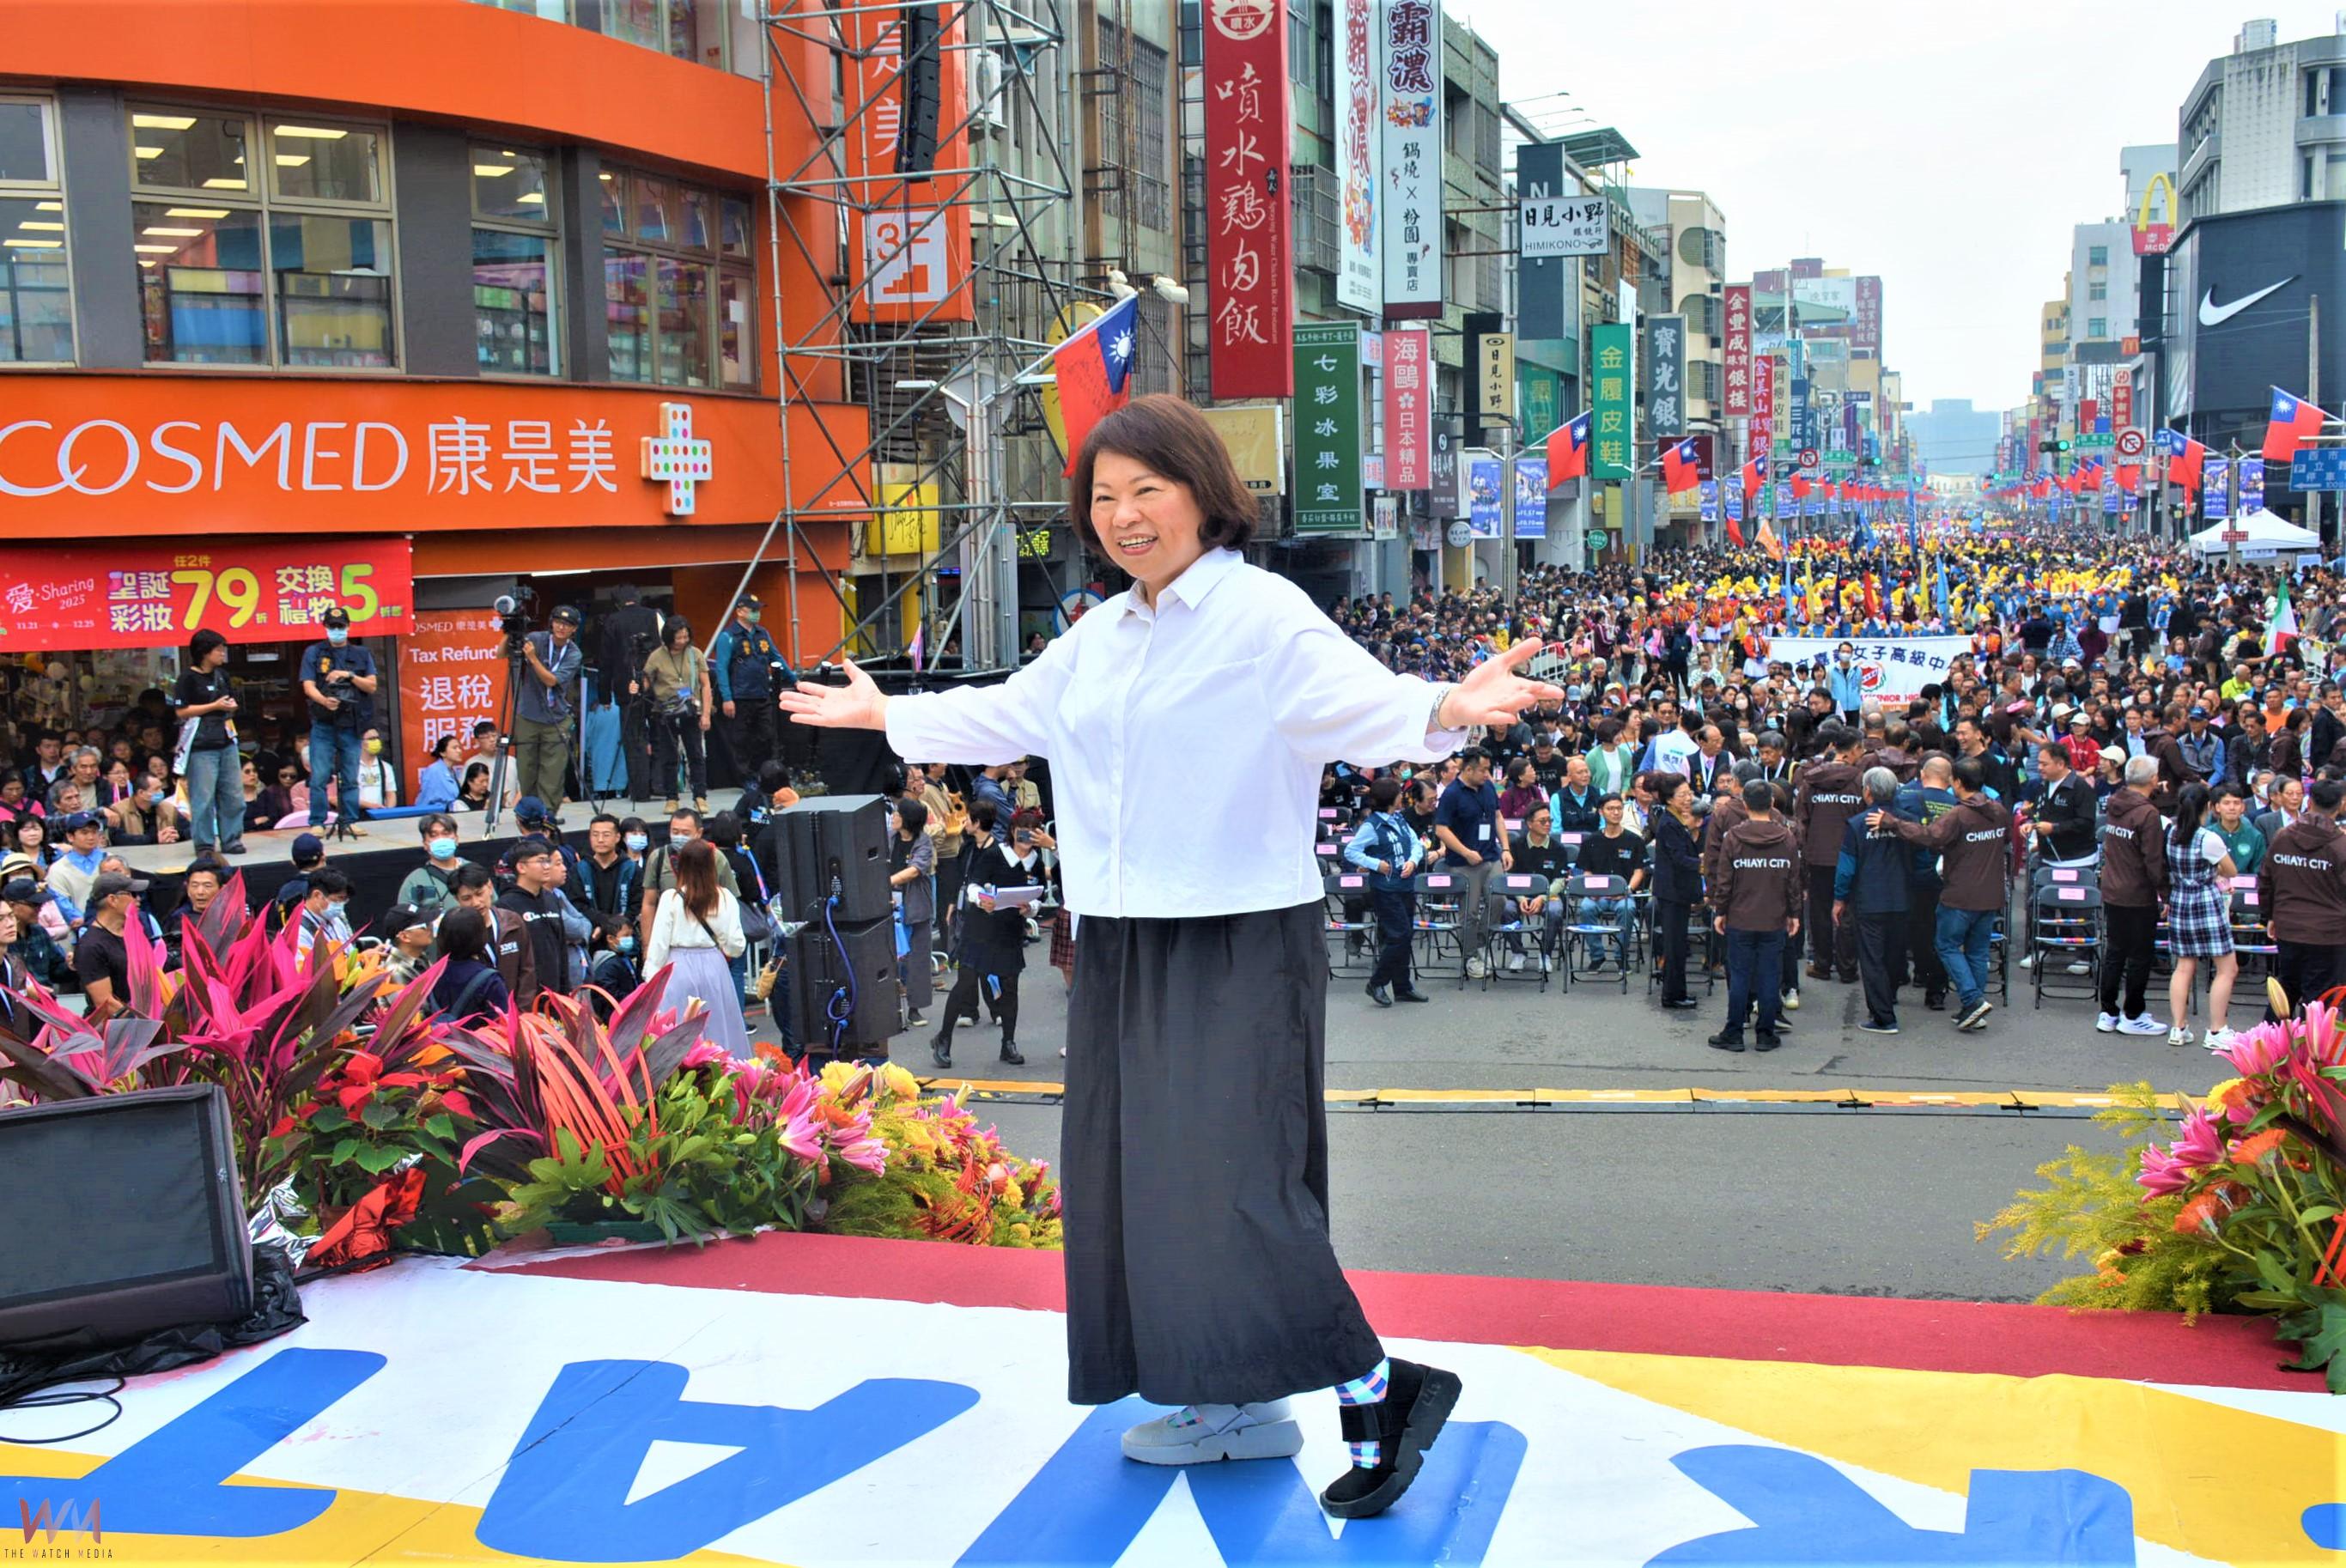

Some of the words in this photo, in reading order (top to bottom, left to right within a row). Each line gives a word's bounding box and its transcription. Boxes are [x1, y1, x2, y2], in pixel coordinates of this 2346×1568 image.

[1389, 1, 1433, 91] 霸濃
[1402, 142, 1420, 179] 鍋燒
[1403, 209, 1420, 244] 粉圓
[1525, 202, 1604, 227] 日見小野
[1525, 240, 1581, 251] HIMIKONO
[1407, 252, 1419, 292] 專賣店
[1490, 349, 1502, 409] 日見小野
[1651, 326, 1680, 440] 寶光銀
[1749, 358, 1772, 455] 金美山珠寶銀
[2115, 387, 2128, 425] 華南銀
[1313, 353, 1340, 501] 七彩冰果室
[0, 418, 410, 496] COSMED
[427, 416, 618, 495] 康是美
[1399, 412, 1415, 483] 日本精品
[108, 571, 171, 599] 聖誕
[276, 564, 335, 594] 交換
[341, 563, 379, 623] 5
[59, 594, 86, 611] 2025
[171, 568, 260, 630] 79
[278, 596, 337, 625] 禮物
[409, 648, 438, 663] Tax
[442, 646, 498, 662] Refund
[420, 674, 494, 711] 退稅
[1811, 794, 1839, 805] CHIAYI
[1840, 793, 1862, 805] CITY
[1966, 829, 1996, 842] CHIAYI
[2116, 825, 2135, 840] CITY
[1733, 858, 1767, 869] CHIAYI
[2273, 853, 2307, 868] CHIAYI
